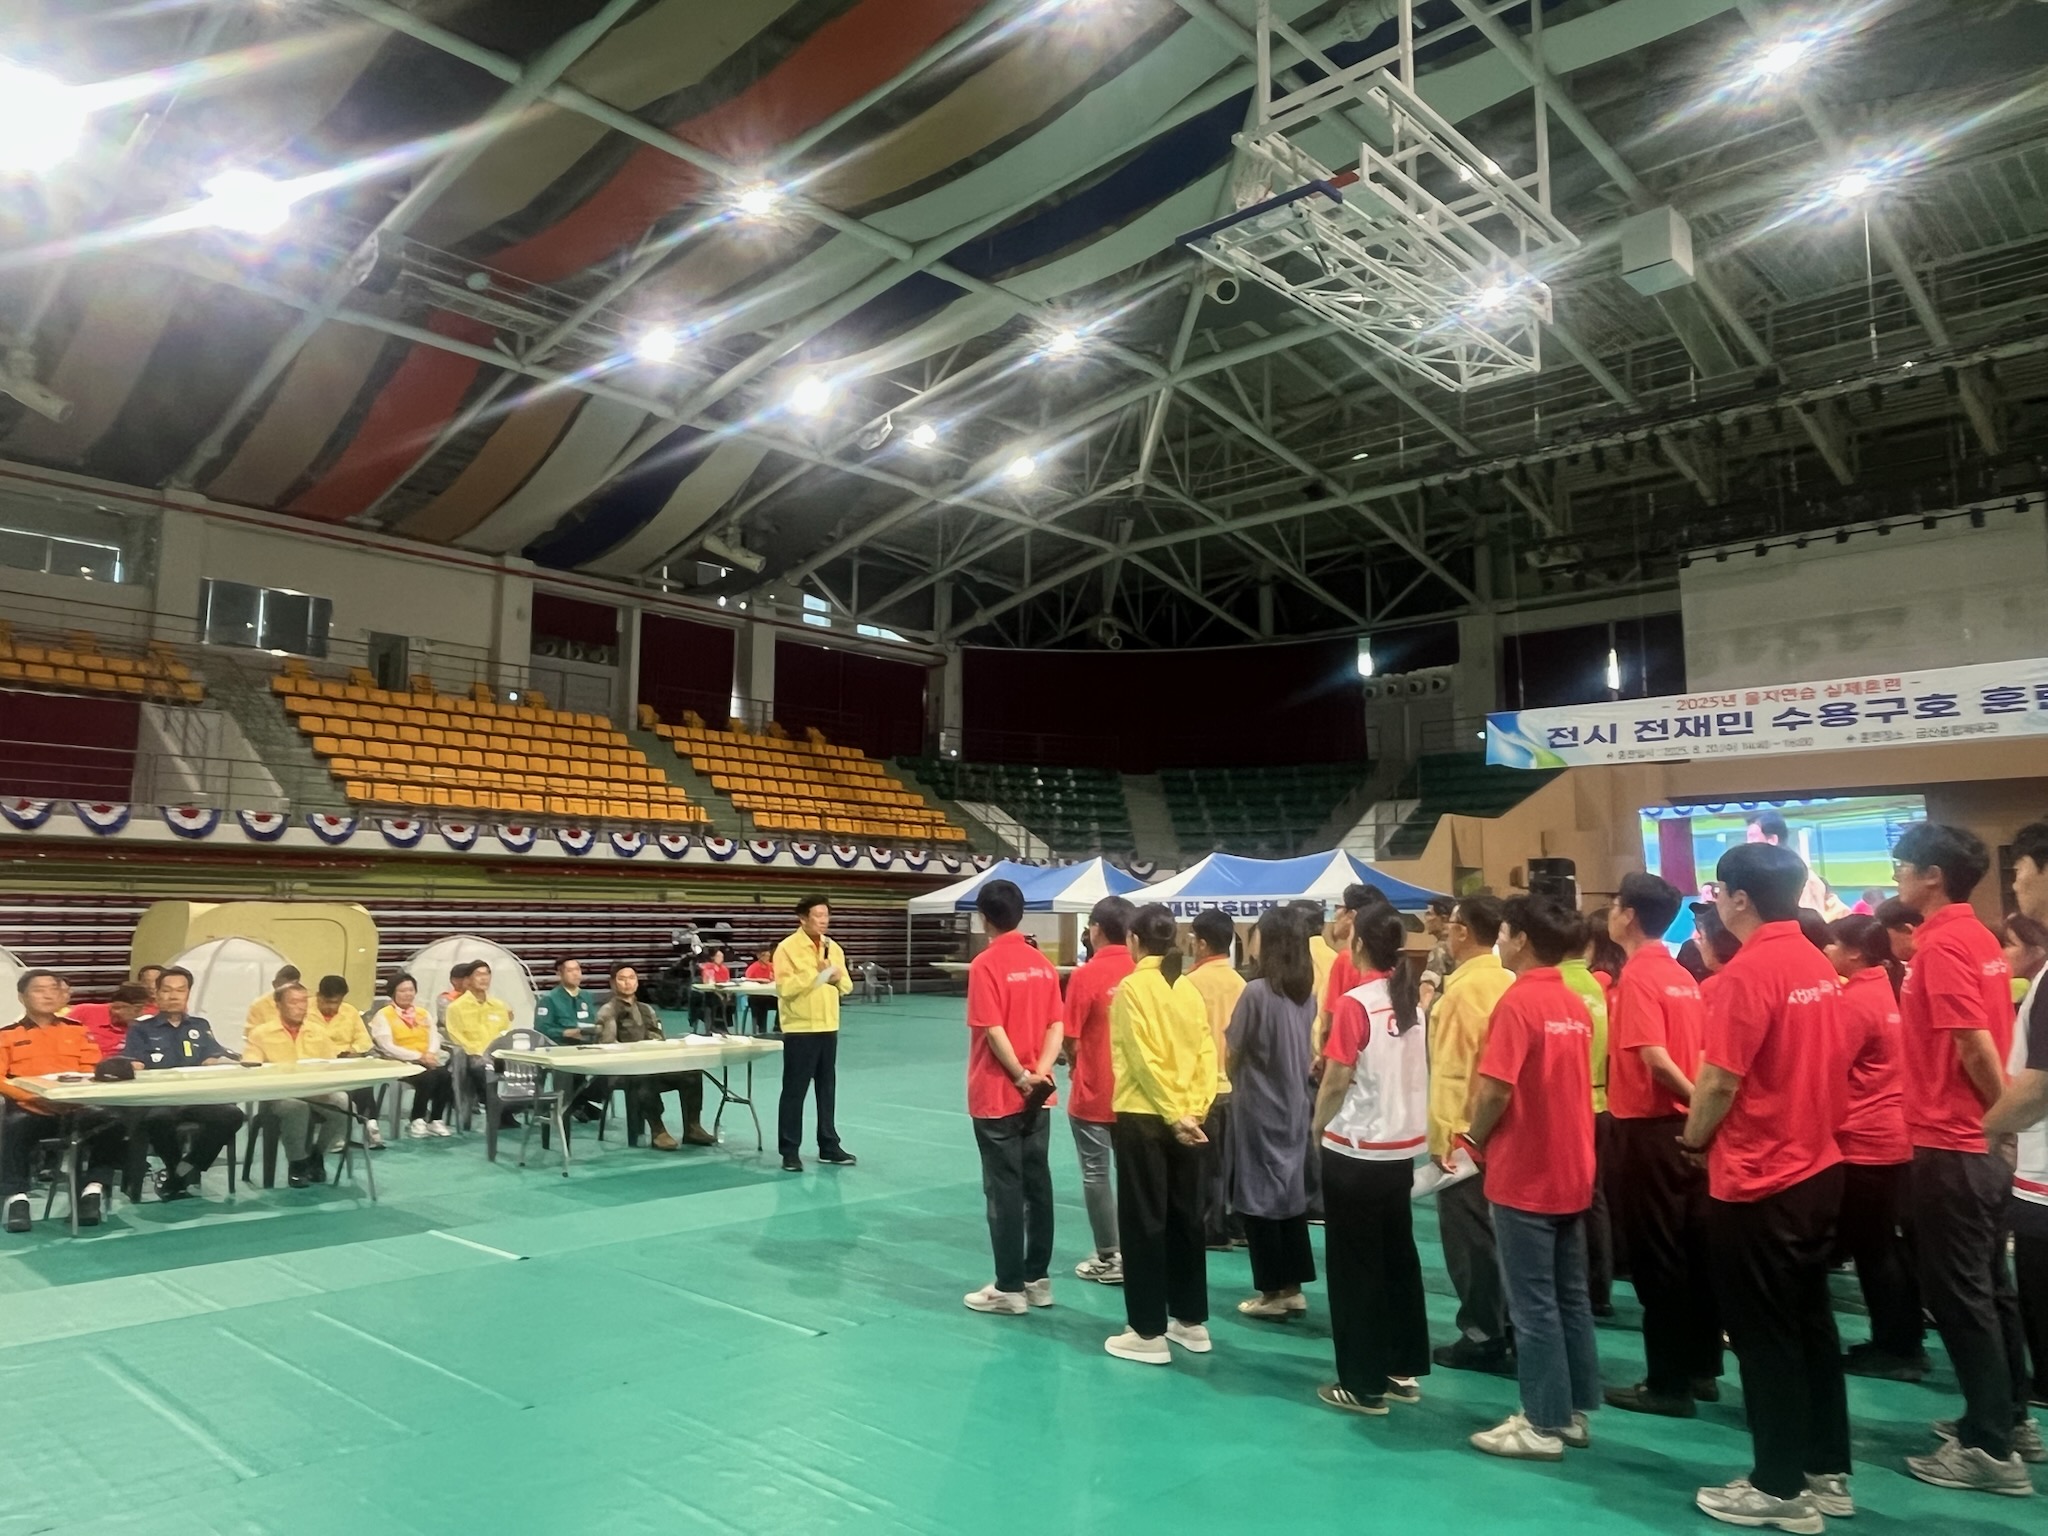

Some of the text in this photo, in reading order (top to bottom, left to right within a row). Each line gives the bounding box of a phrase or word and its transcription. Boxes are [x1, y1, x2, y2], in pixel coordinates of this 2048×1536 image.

[1676, 677, 1902, 712] 2025년 을지연습 실제훈련
[1546, 722, 1618, 749] 전시
[1634, 710, 1755, 743] 전재민
[1771, 693, 1962, 732] 수용구호
